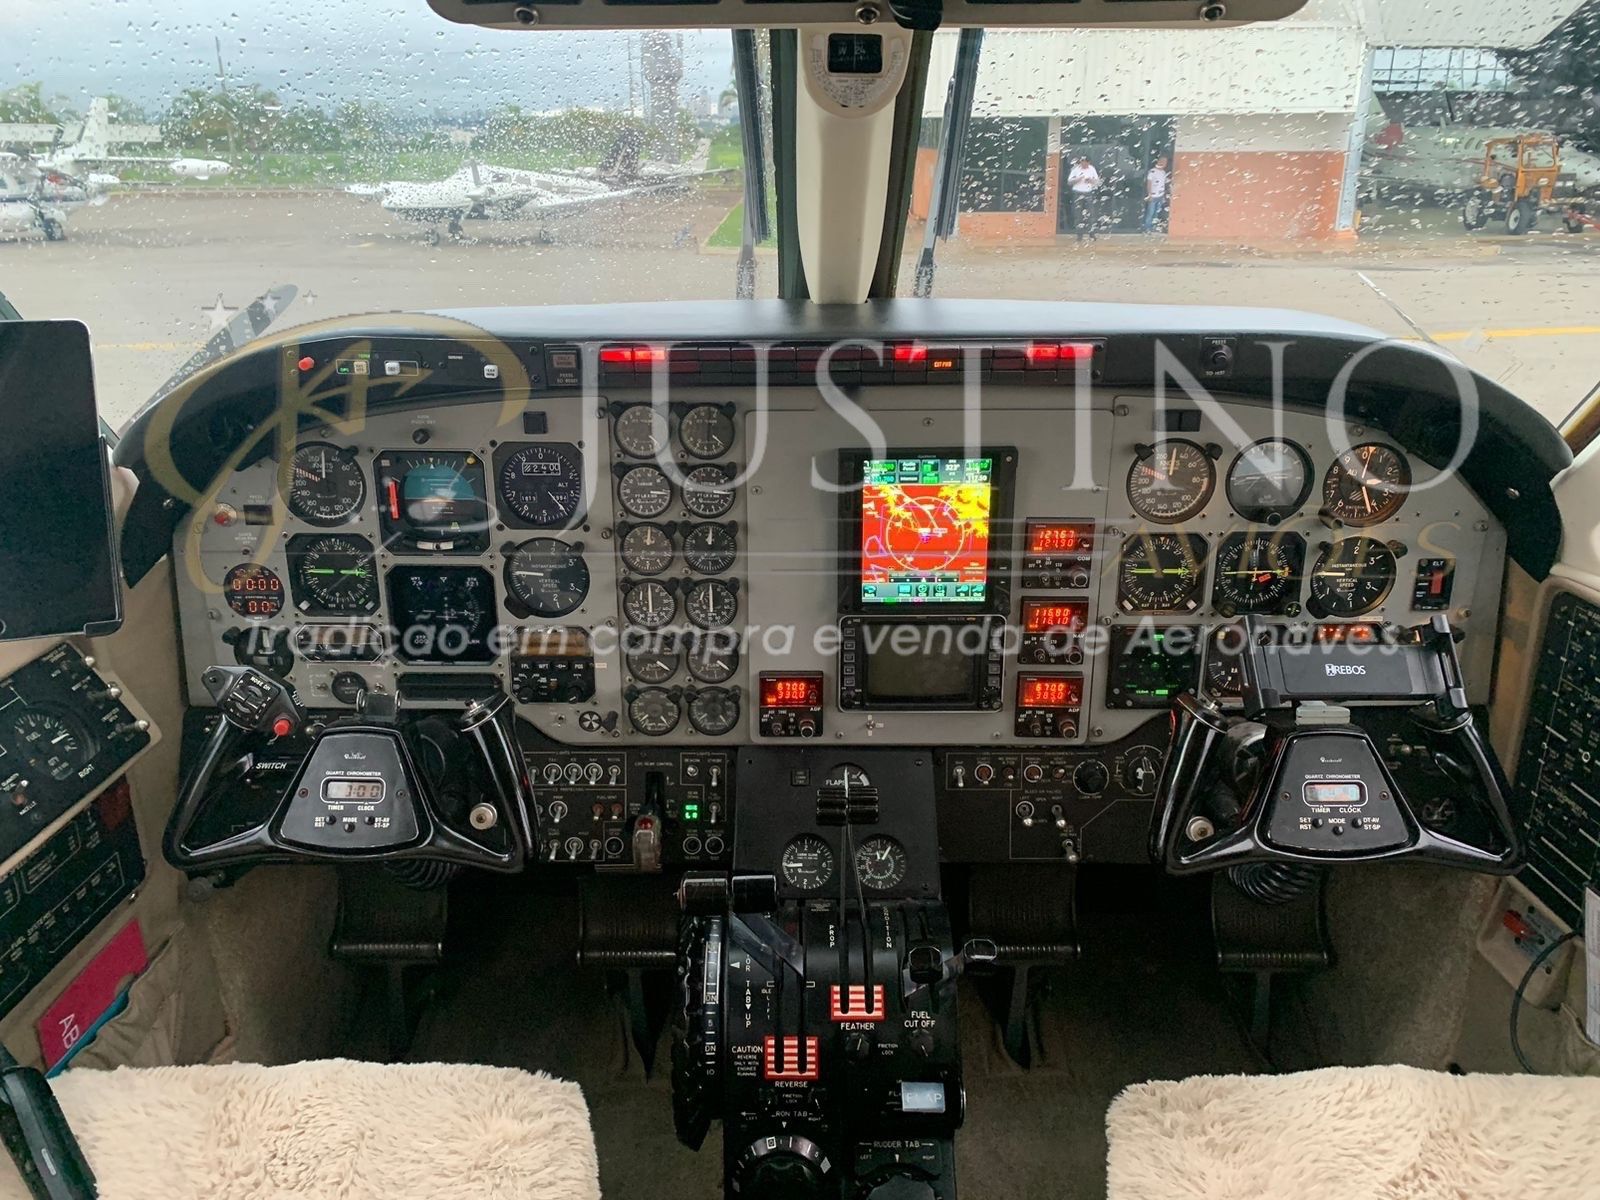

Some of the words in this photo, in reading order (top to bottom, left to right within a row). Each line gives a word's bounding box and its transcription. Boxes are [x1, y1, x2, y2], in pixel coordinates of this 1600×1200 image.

[256, 762, 287, 770] SWITCH
[911, 1011, 930, 1019] FUEL
[745, 1013, 751, 1028] UP
[904, 1020, 918, 1028] CUT
[921, 1020, 936, 1028] OFF
[840, 1022, 875, 1030] FEATHER
[58, 1013, 80, 1050] AB
[731, 1045, 763, 1053] CAUTION
[873, 1140, 901, 1148] RUDDER
[904, 1140, 921, 1148] TAB
